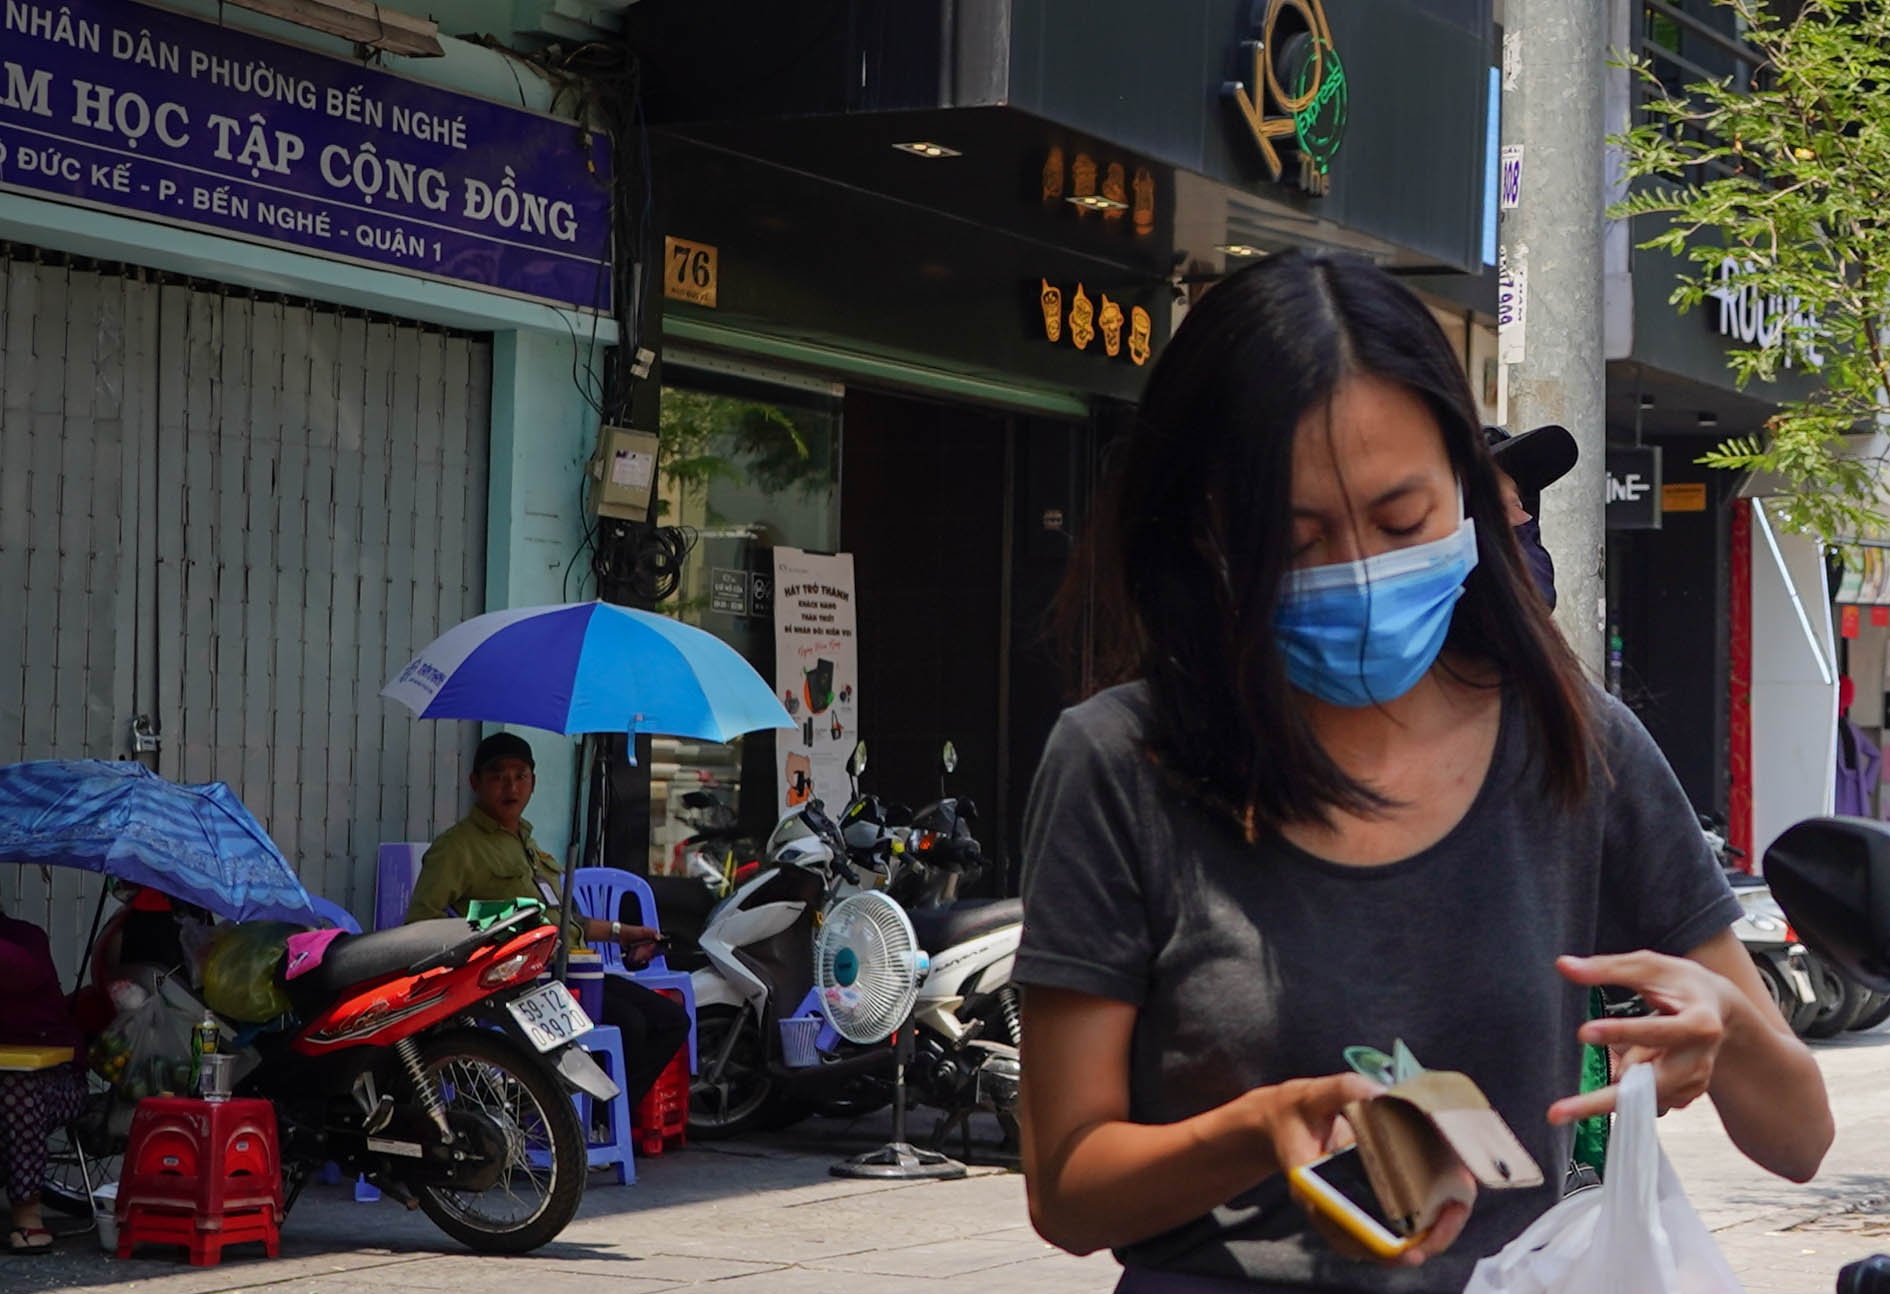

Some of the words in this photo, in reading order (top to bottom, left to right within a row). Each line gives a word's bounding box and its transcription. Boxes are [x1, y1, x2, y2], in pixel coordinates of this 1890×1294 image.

[5, 0, 101, 54] NHÂN
[112, 28, 181, 74] DÂN
[190, 51, 317, 111] PHƯỜNG
[326, 84, 384, 129] BẾN
[391, 106, 469, 151] NGHÉ
[0, 61, 54, 117] M
[71, 79, 190, 149] HỌC
[207, 111, 305, 178] TẬP
[319, 141, 450, 213] CỘNG
[462, 165, 579, 243] ĐỒNG
[17, 146, 81, 182] ĐỨC
[91, 162, 133, 193] KẾ
[158, 178, 185, 206] P.
[192, 185, 249, 220] BẾN
[257, 202, 332, 238] NGHÉ
[354, 224, 425, 258] QUẬN
[432, 241, 442, 262] 1
[674, 244, 710, 288] 76
[518, 989, 568, 1023] 59-T2
